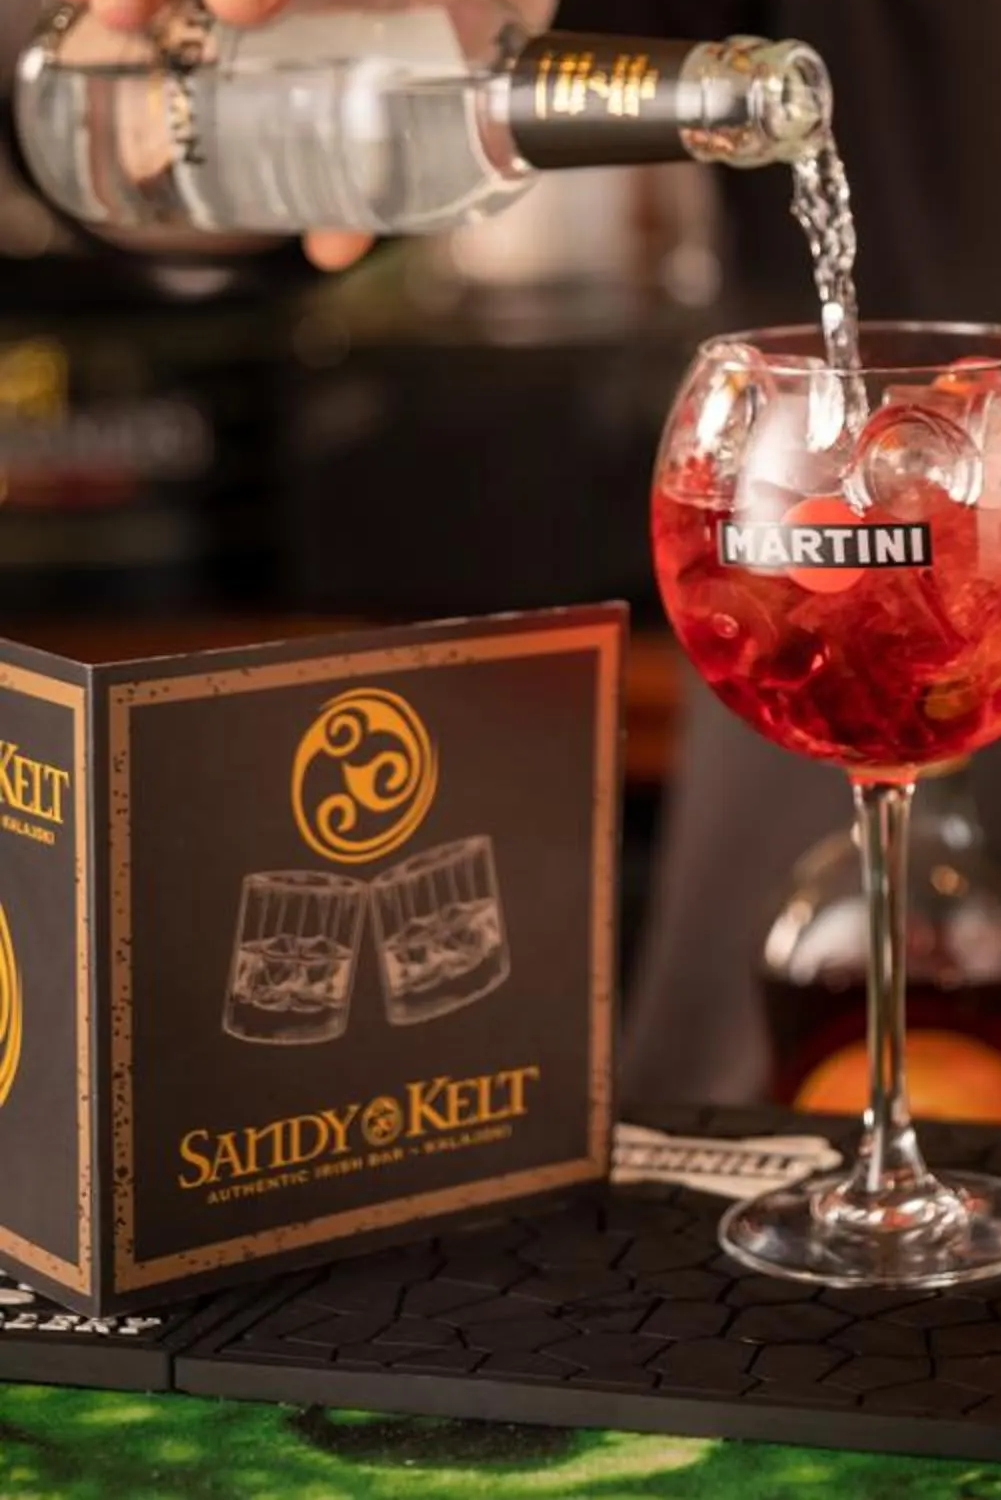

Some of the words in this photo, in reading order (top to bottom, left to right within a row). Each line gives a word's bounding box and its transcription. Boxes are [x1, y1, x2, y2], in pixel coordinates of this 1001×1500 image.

[725, 524, 924, 564] MARTINI
[178, 1103, 361, 1190] SANDY
[405, 1065, 540, 1137] KELT
[207, 1168, 309, 1205] AUTHENTIC
